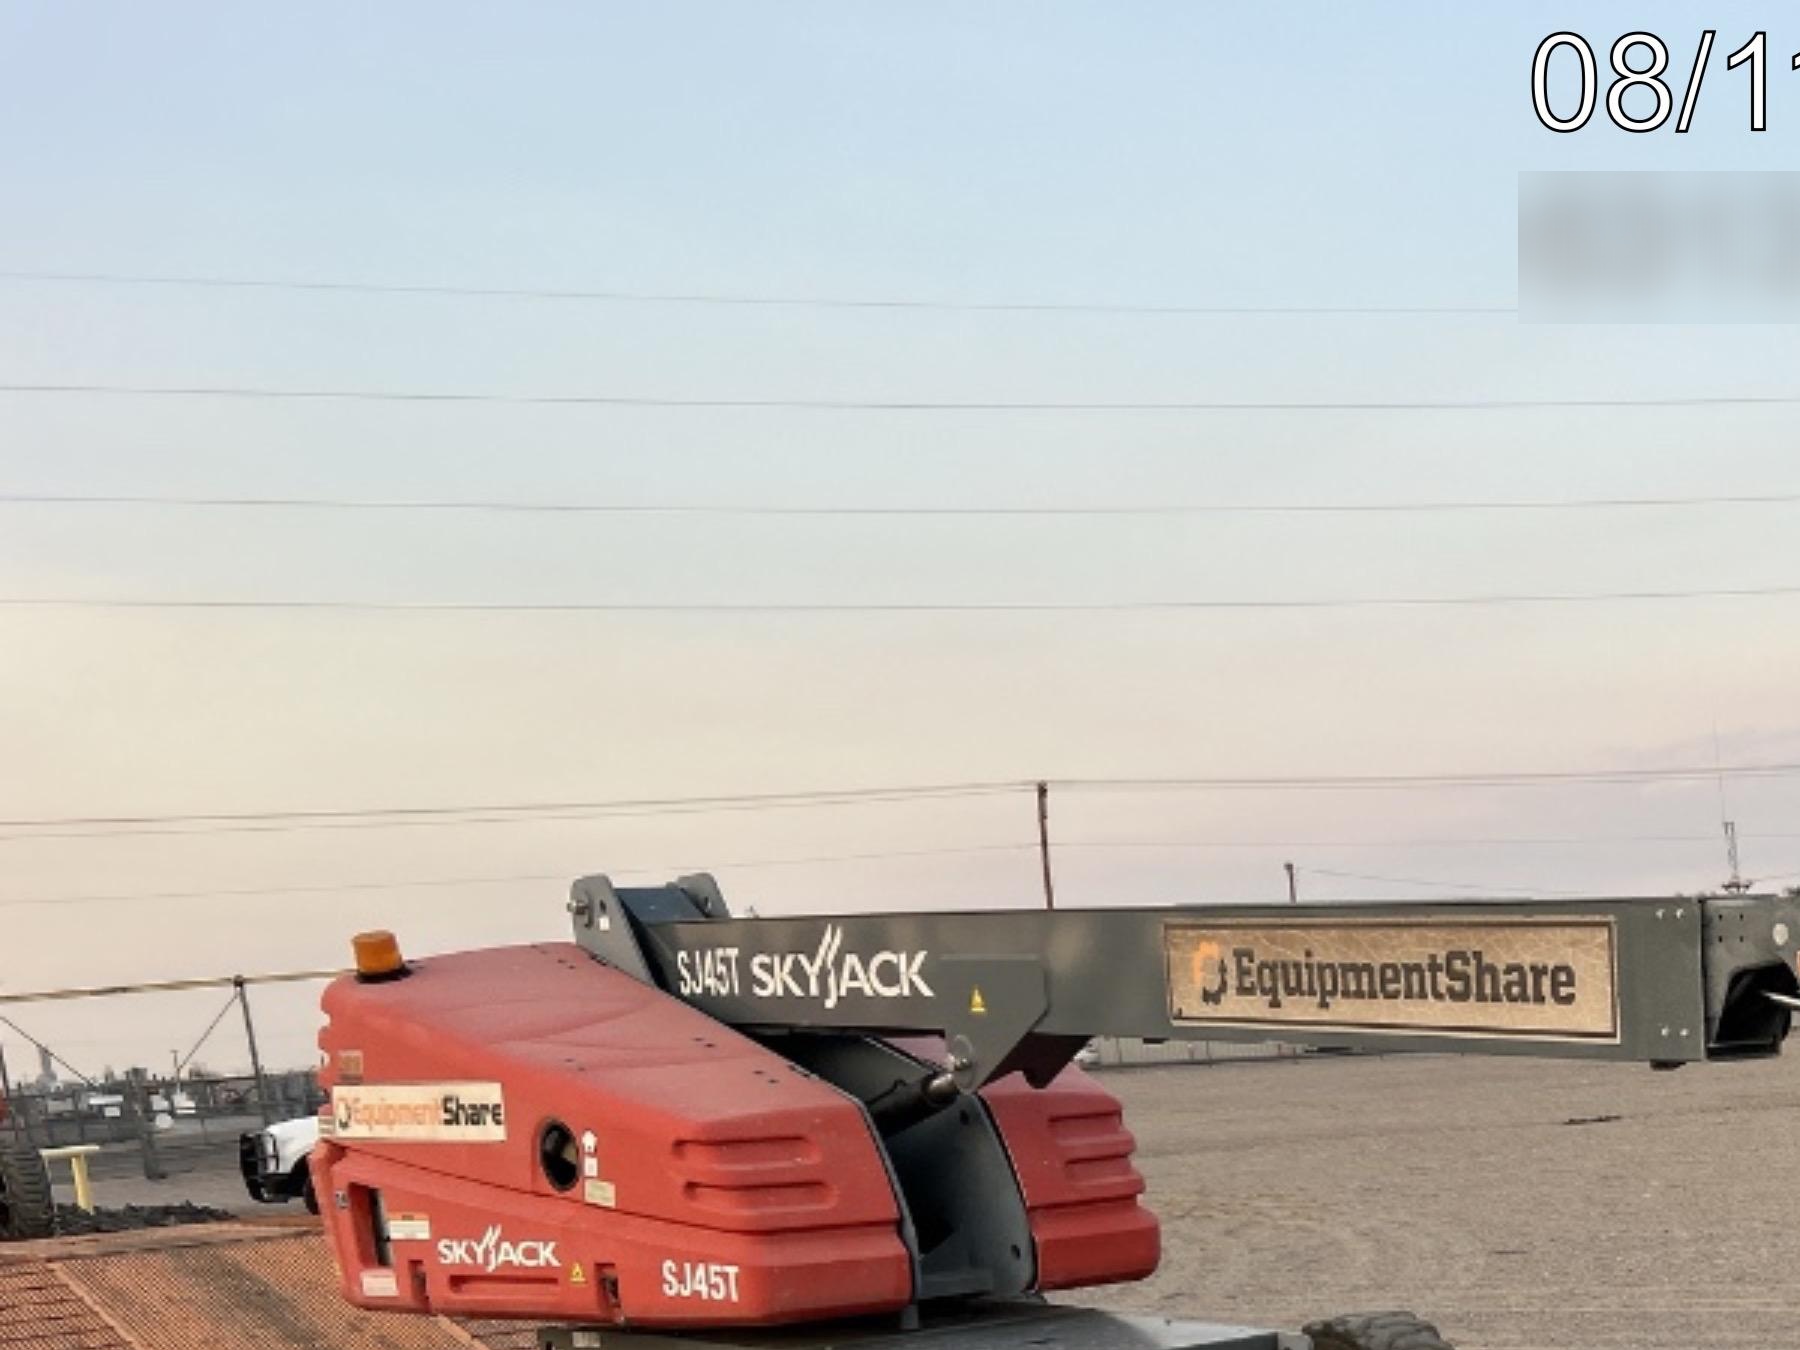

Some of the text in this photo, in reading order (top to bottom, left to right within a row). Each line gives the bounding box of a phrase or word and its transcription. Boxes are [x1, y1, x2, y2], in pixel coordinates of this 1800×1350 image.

[677, 922, 936, 1009] SJ45T SKYJACK
[1232, 946, 1577, 1010] EquipmentShare
[352, 1095, 504, 1132] EquipmentShare
[437, 1224, 561, 1273] SKYJACK
[662, 1258, 740, 1303] SJ45T
